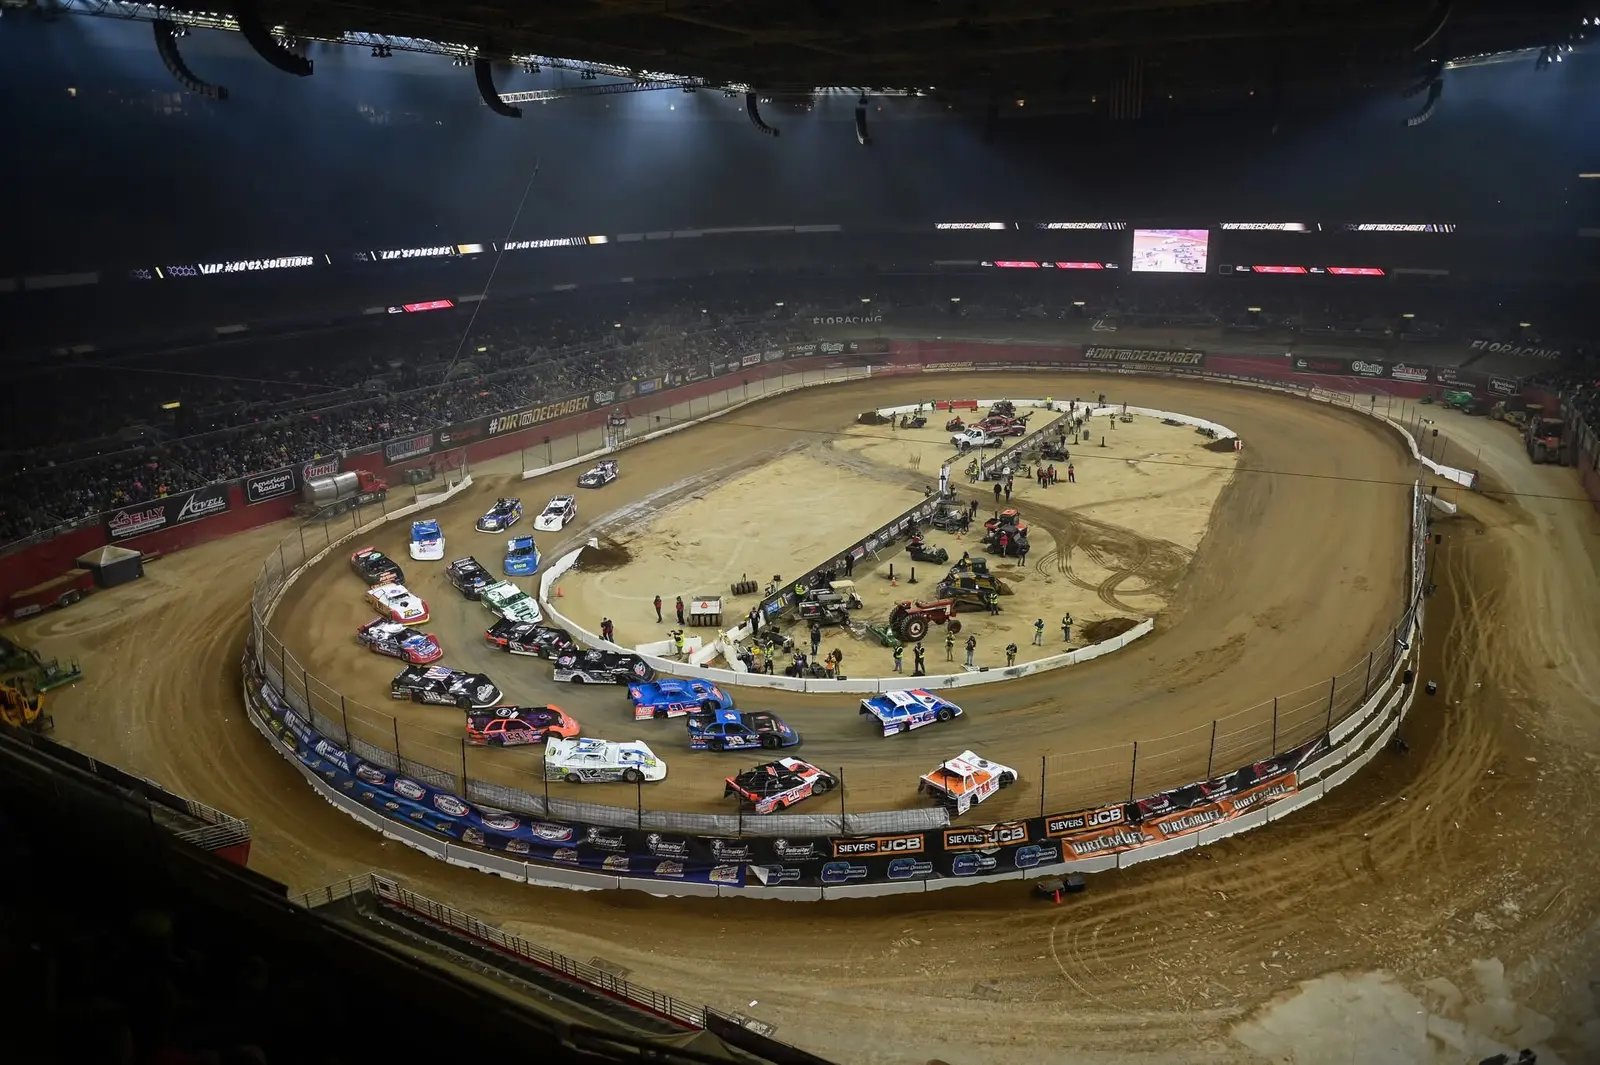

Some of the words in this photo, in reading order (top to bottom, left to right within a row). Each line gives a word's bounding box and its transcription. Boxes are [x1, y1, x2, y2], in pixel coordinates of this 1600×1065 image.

[382, 250, 401, 260] LAP
[402, 246, 451, 258] SPONSORS
[504, 242, 516, 250] LAP
[204, 263, 224, 274] LAP
[224, 262, 246, 273] #40
[247, 260, 261, 270] C2
[262, 256, 314, 269] SOLUTIONS
[1352, 360, 1383, 374] O'Reilly
[252, 474, 290, 489] American
[258, 481, 286, 493] Racing
[786, 789, 800, 801] 20
[1050, 818, 1084, 831] SIEVERS
[1088, 808, 1121, 826] JCB
[838, 843, 876, 853] SIEVERS
[881, 838, 920, 851] JCB
